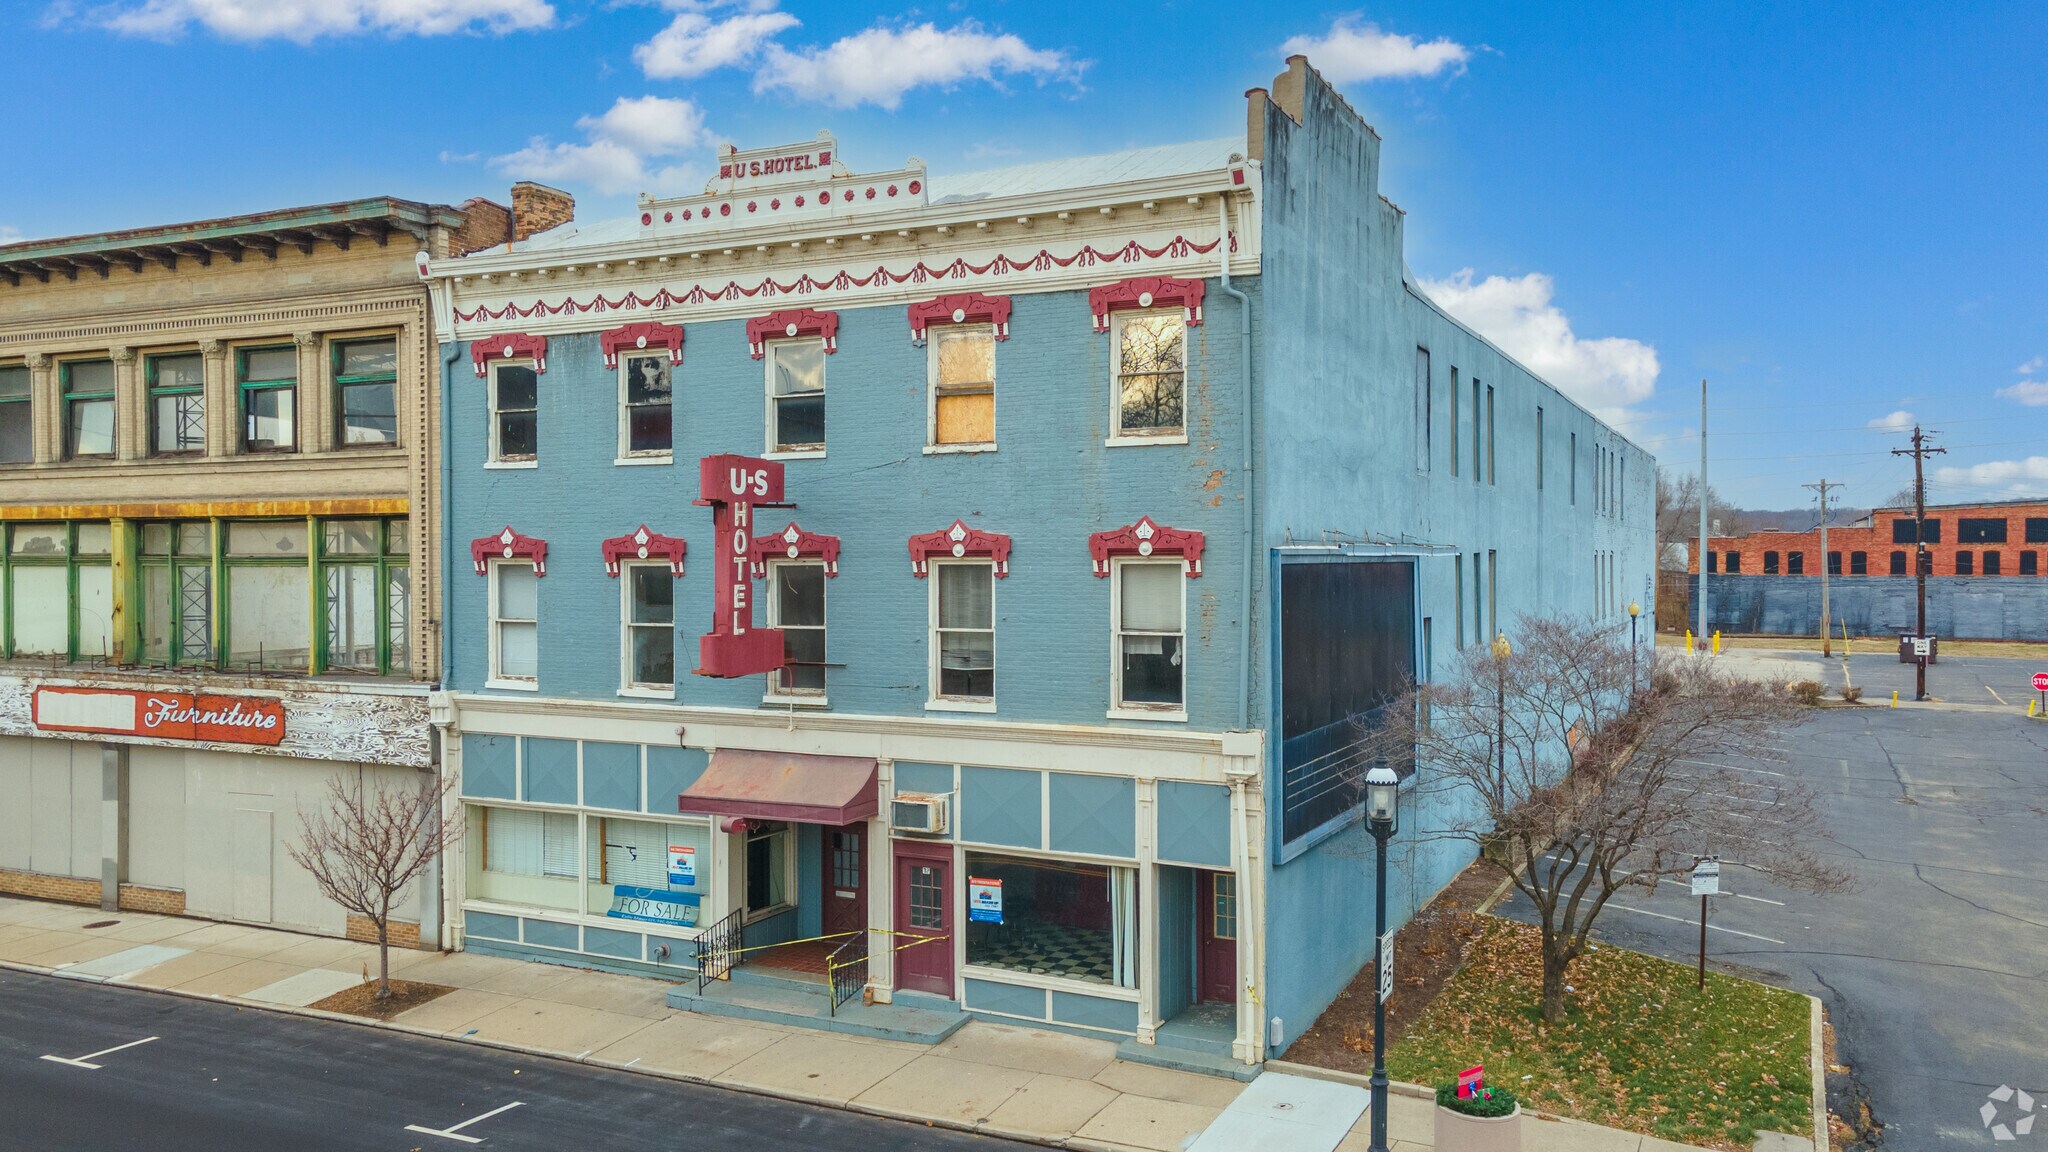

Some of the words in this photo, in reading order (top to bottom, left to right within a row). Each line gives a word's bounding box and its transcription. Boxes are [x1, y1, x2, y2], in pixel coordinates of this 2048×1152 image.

[733, 501, 747, 636] HOTEL
[144, 698, 277, 729] Furniture
[619, 898, 649, 915] FOR
[654, 902, 691, 920] SALE
[1383, 964, 1392, 994] 25
